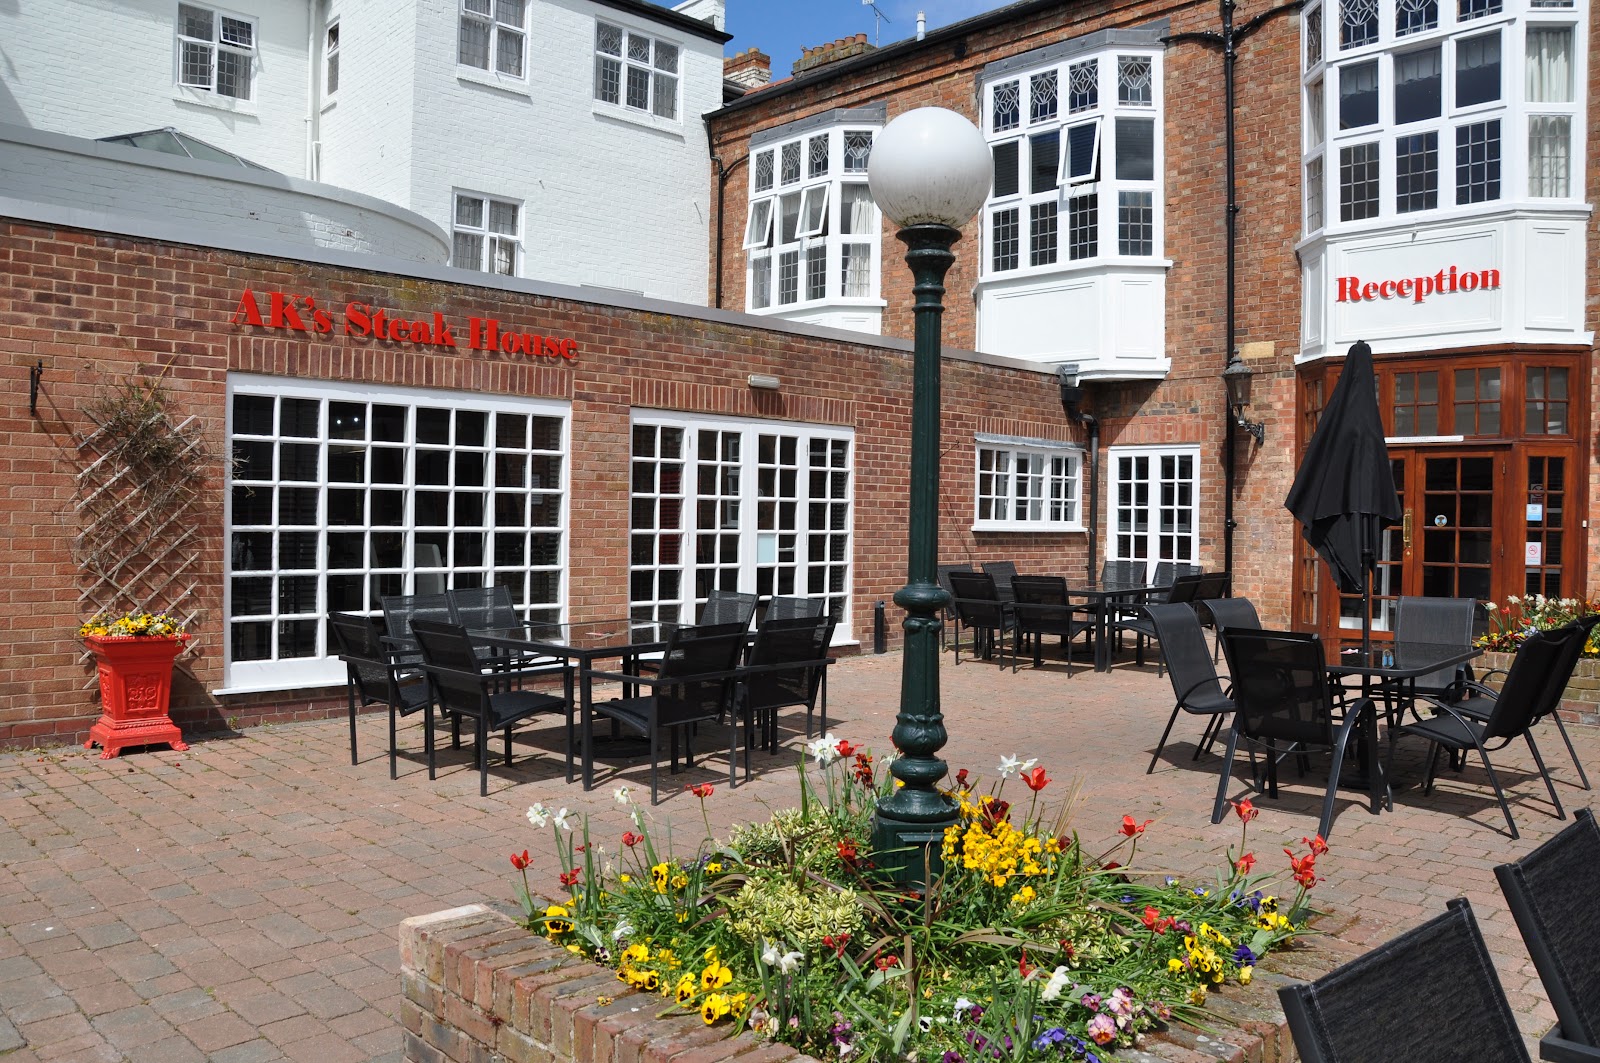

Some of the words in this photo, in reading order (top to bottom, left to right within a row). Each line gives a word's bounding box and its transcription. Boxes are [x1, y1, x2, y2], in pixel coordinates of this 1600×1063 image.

[1336, 265, 1501, 304] Reception
[230, 288, 333, 333] AK's
[344, 301, 458, 347] Steak
[466, 315, 578, 359] House
